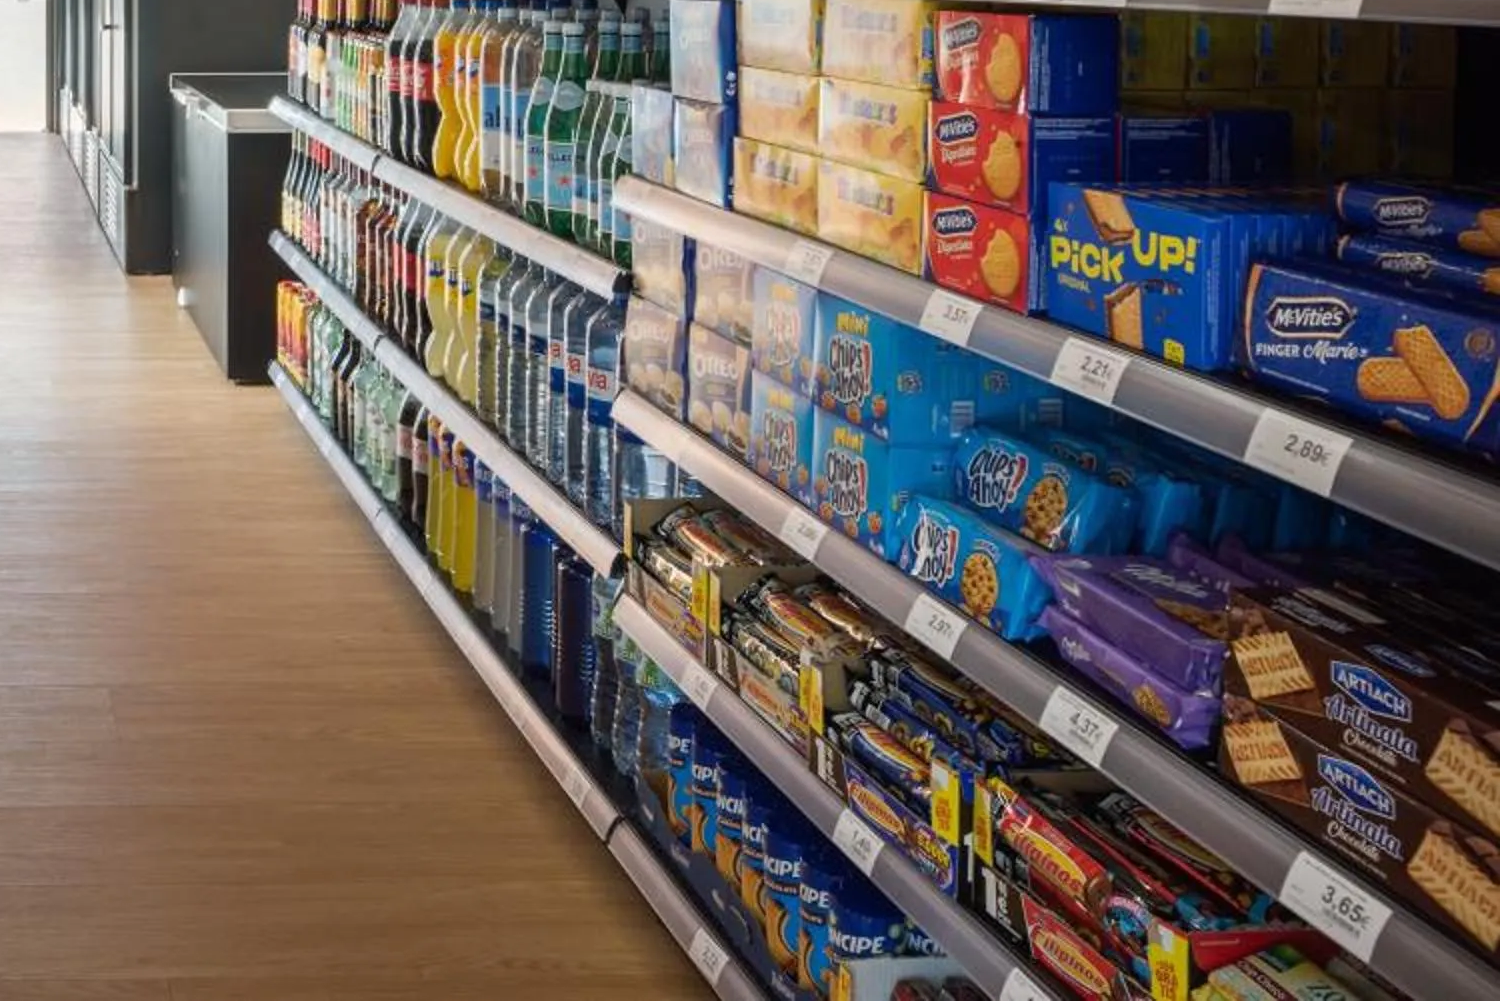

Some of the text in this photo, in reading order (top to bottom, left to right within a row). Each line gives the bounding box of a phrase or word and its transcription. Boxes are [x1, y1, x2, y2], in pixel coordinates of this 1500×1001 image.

[1131, 228, 1199, 275] UP!
[836, 312, 869, 336] mini
[1273, 302, 1345, 329] McVitie's
[694, 354, 739, 380] OREO
[830, 336, 862, 374] Chips
[1256, 340, 1360, 365] FINGER Marie
[827, 451, 859, 484] Chips
[969, 449, 1017, 477] Chips
[1284, 435, 1332, 468] 2,89€
[1337, 670, 1409, 719] ARTIACH
[1324, 694, 1420, 763] Artinata
[1324, 764, 1393, 815] ARTIACH
[1311, 787, 1402, 861] Artinata
[1322, 885, 1371, 930] 3,65€
